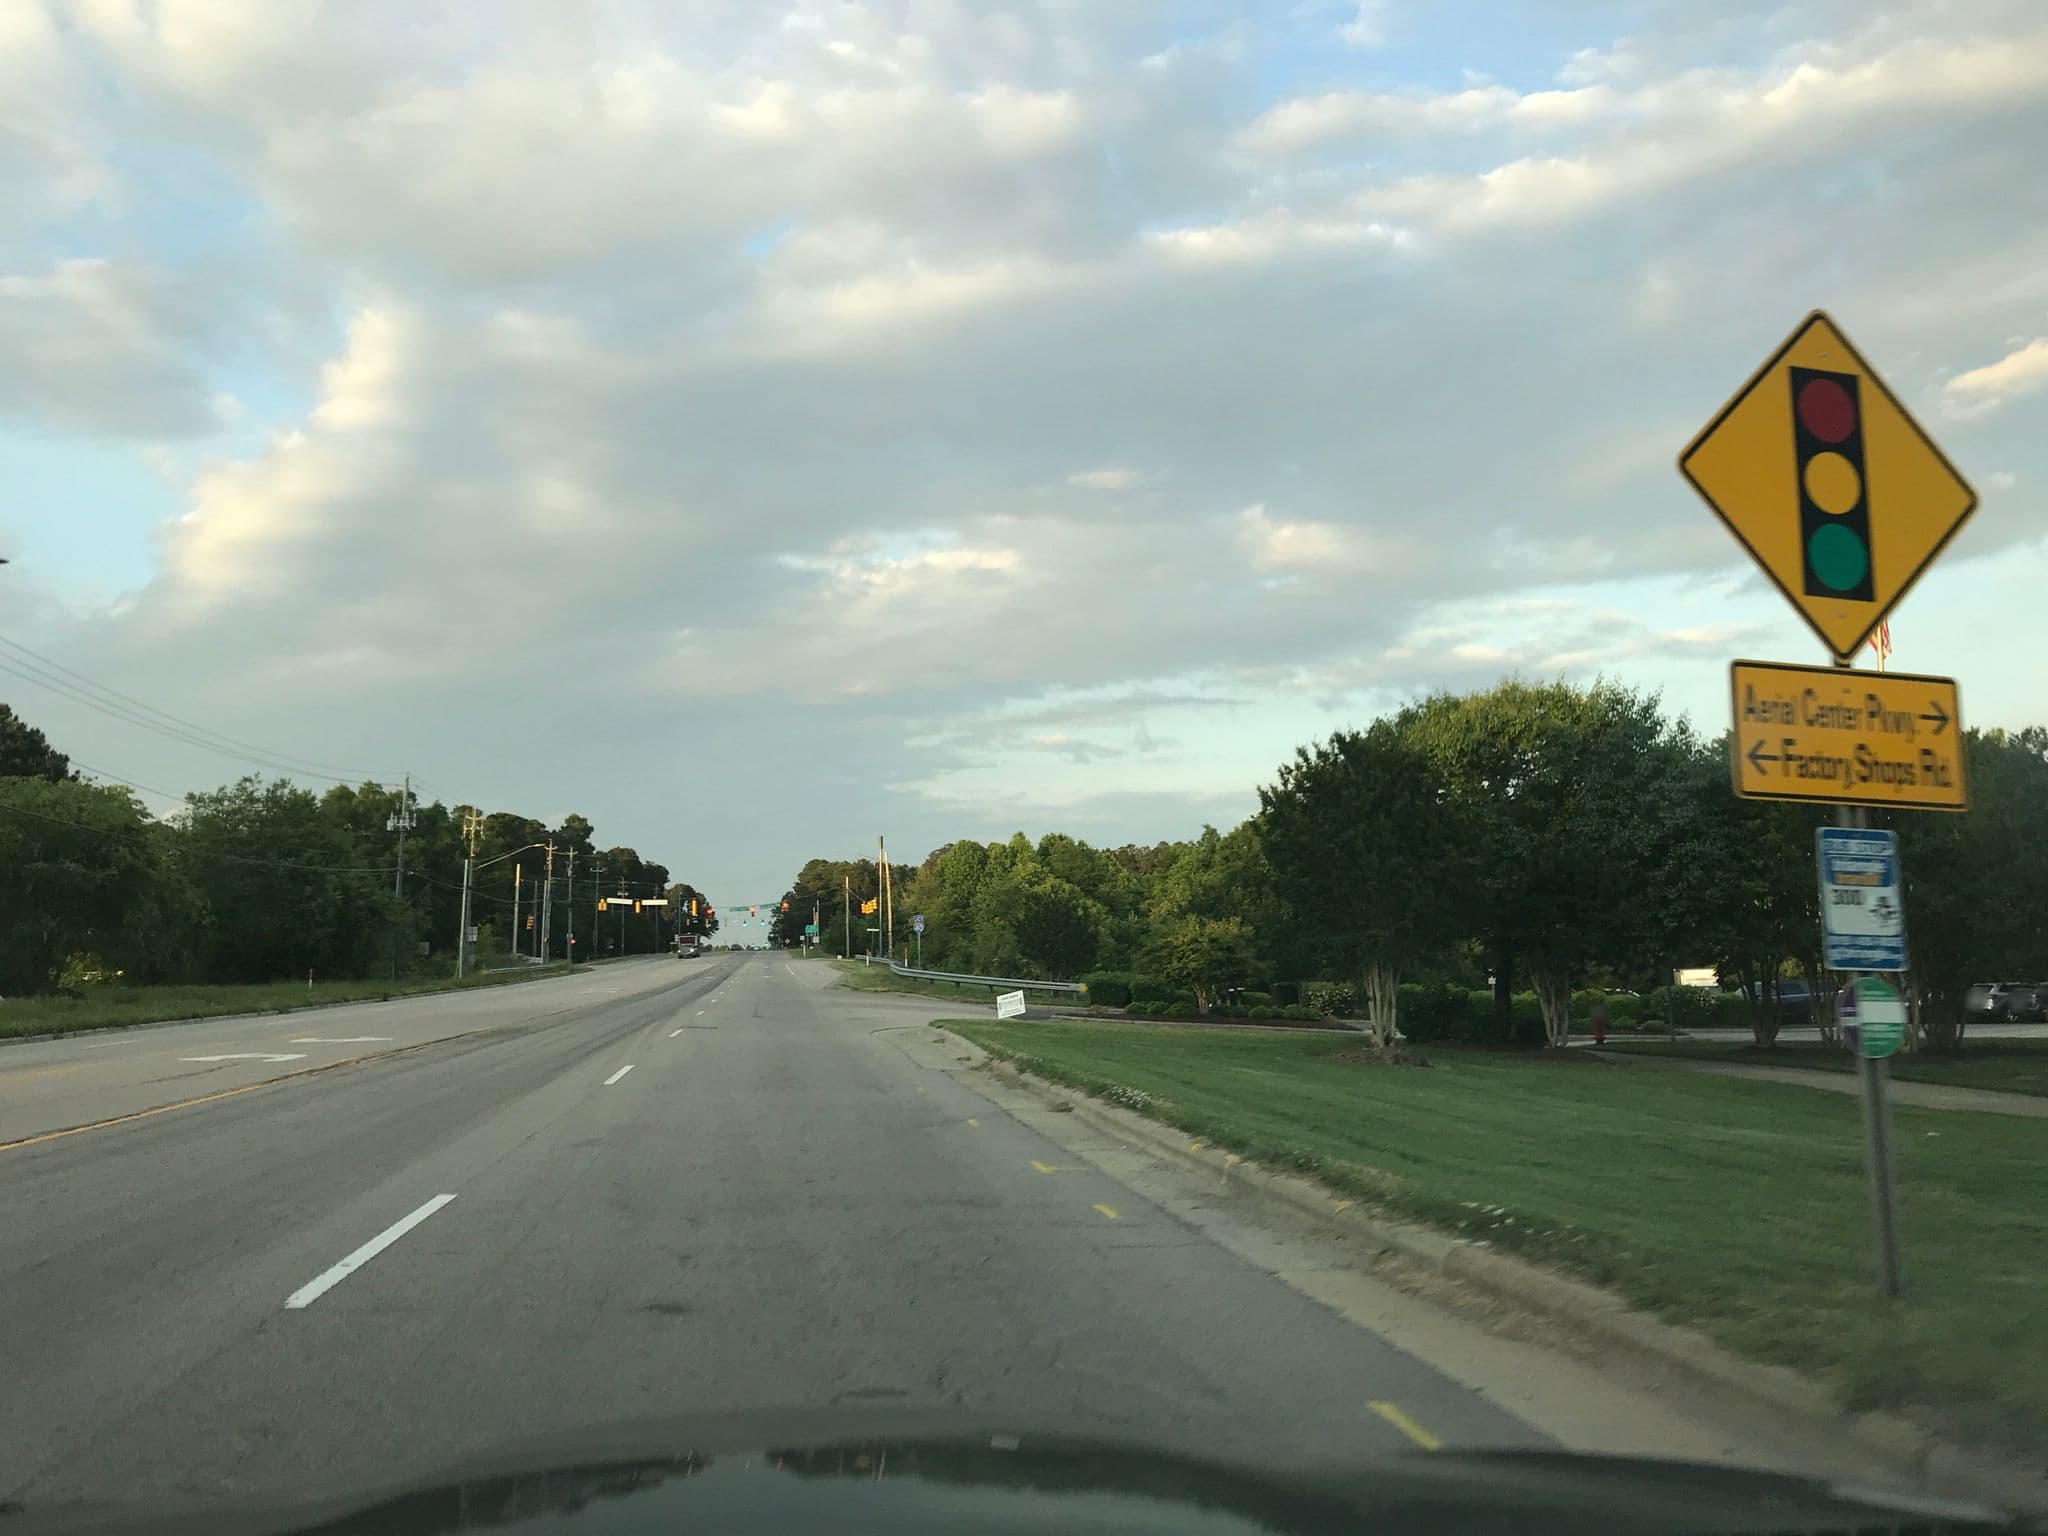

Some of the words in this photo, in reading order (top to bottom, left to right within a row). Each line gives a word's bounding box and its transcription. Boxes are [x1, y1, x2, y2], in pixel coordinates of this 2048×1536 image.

[1744, 684, 1799, 726] Aerial
[1801, 687, 1863, 730] Center
[1781, 738, 1854, 791] Factory
[1855, 743, 1917, 793] Shops
